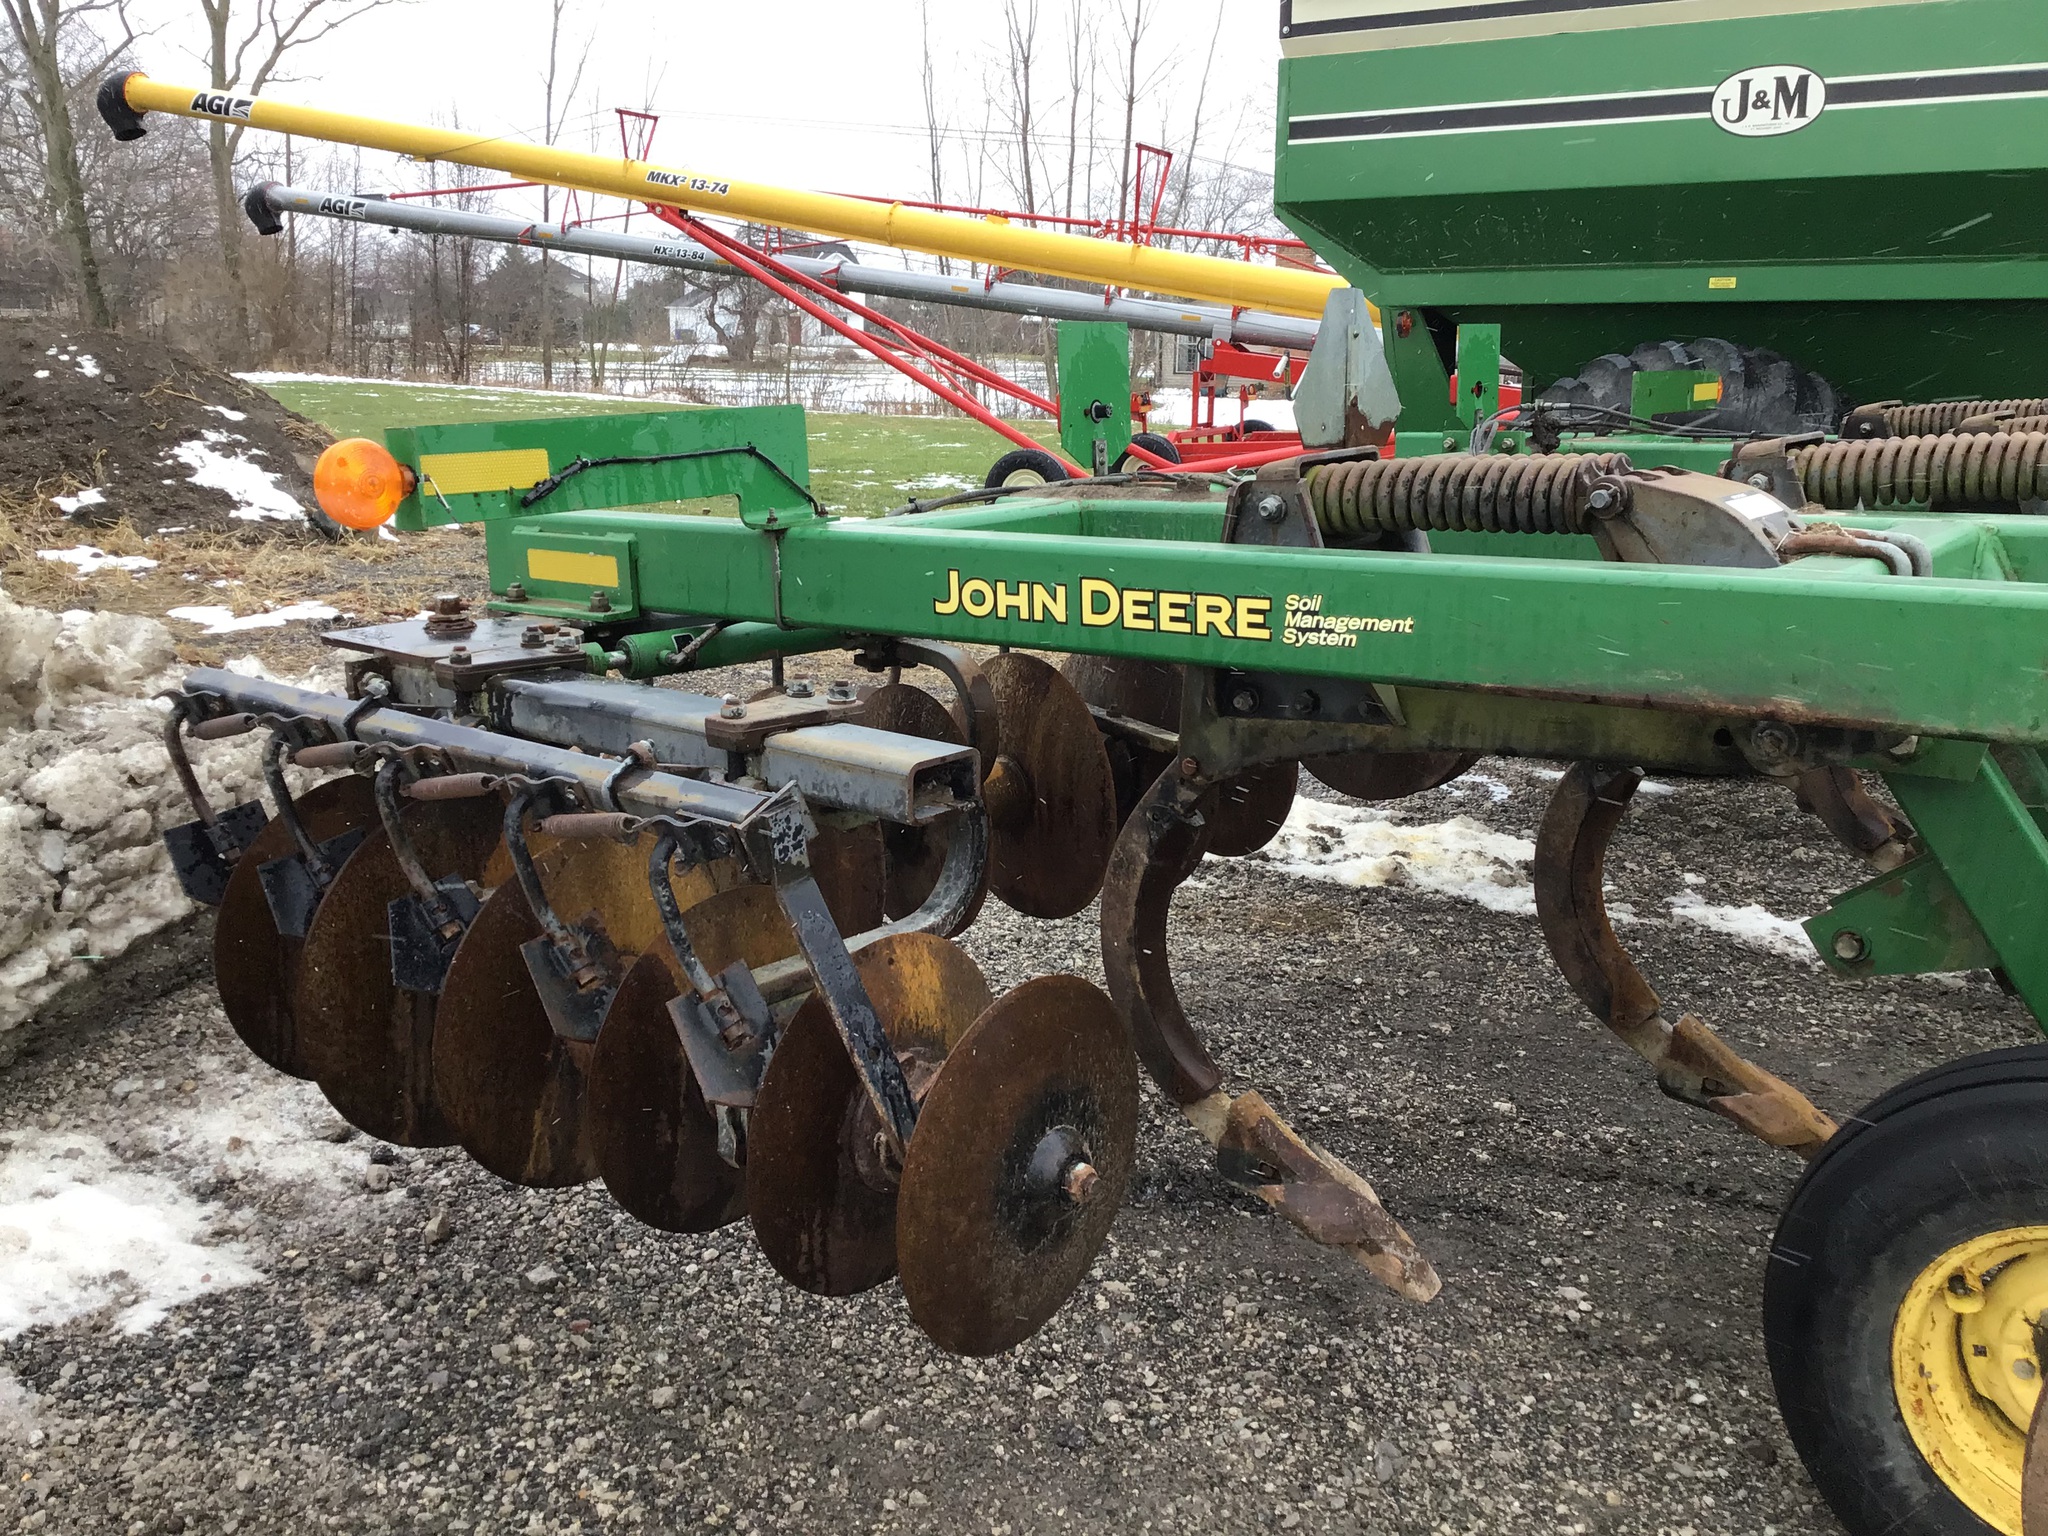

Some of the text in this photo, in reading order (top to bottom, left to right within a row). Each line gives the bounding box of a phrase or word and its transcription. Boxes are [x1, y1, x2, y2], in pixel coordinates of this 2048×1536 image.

[191, 92, 234, 117] AGI
[1721, 73, 1812, 124] J&M
[690, 178, 729, 195] 13-74
[320, 197, 352, 216] AGI
[676, 248, 706, 261] 13-84
[1284, 593, 1323, 612] Soil
[1284, 611, 1415, 634] Management
[1282, 627, 1358, 648] System
